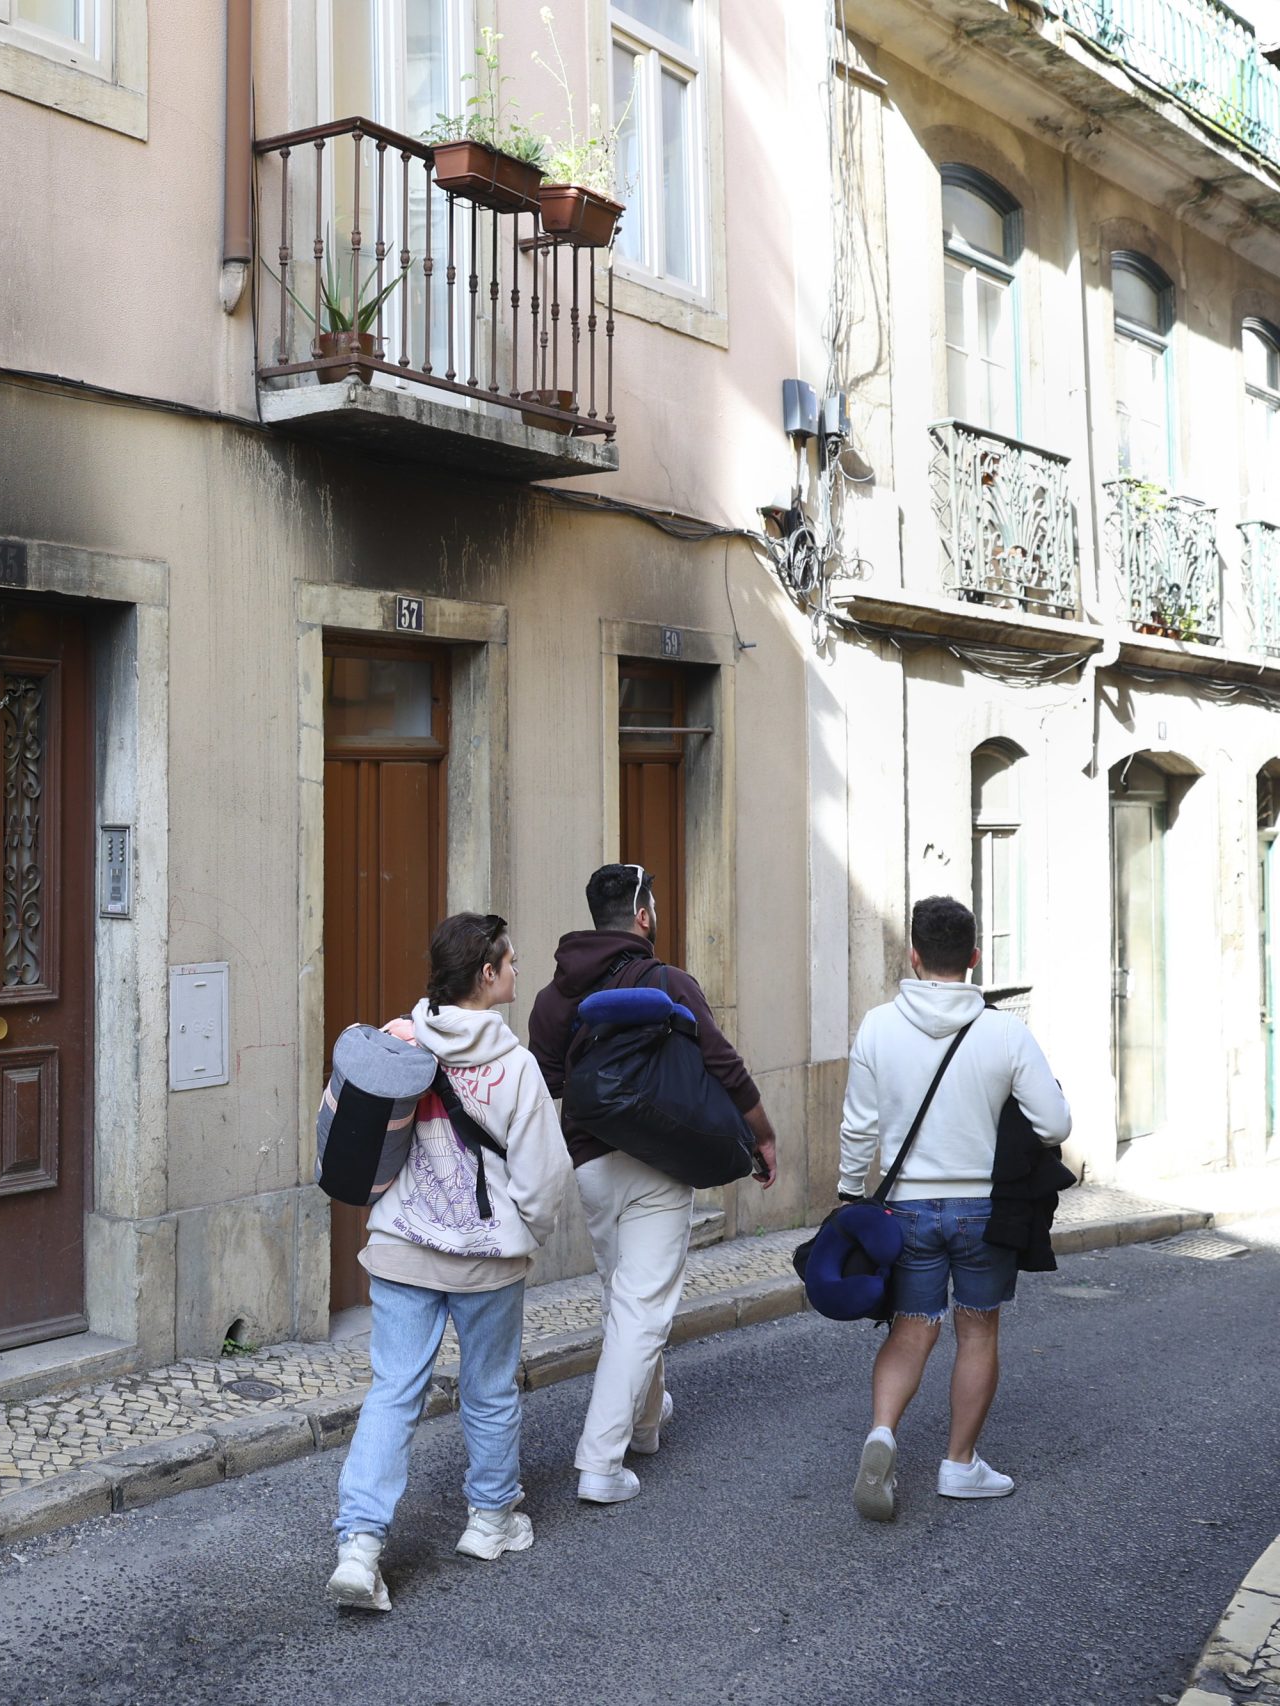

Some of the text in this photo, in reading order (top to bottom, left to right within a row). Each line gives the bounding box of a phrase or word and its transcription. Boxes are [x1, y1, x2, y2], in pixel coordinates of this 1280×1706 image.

[401, 599, 418, 629] 57
[665, 631, 678, 655] 59
[391, 1216, 405, 1232] Video
[404, 1226, 424, 1244] Empty
[426, 1238, 442, 1252] Soul
[448, 1248, 464, 1257] New
[465, 1249, 489, 1257] Jersey
[489, 1246, 503, 1257] City
